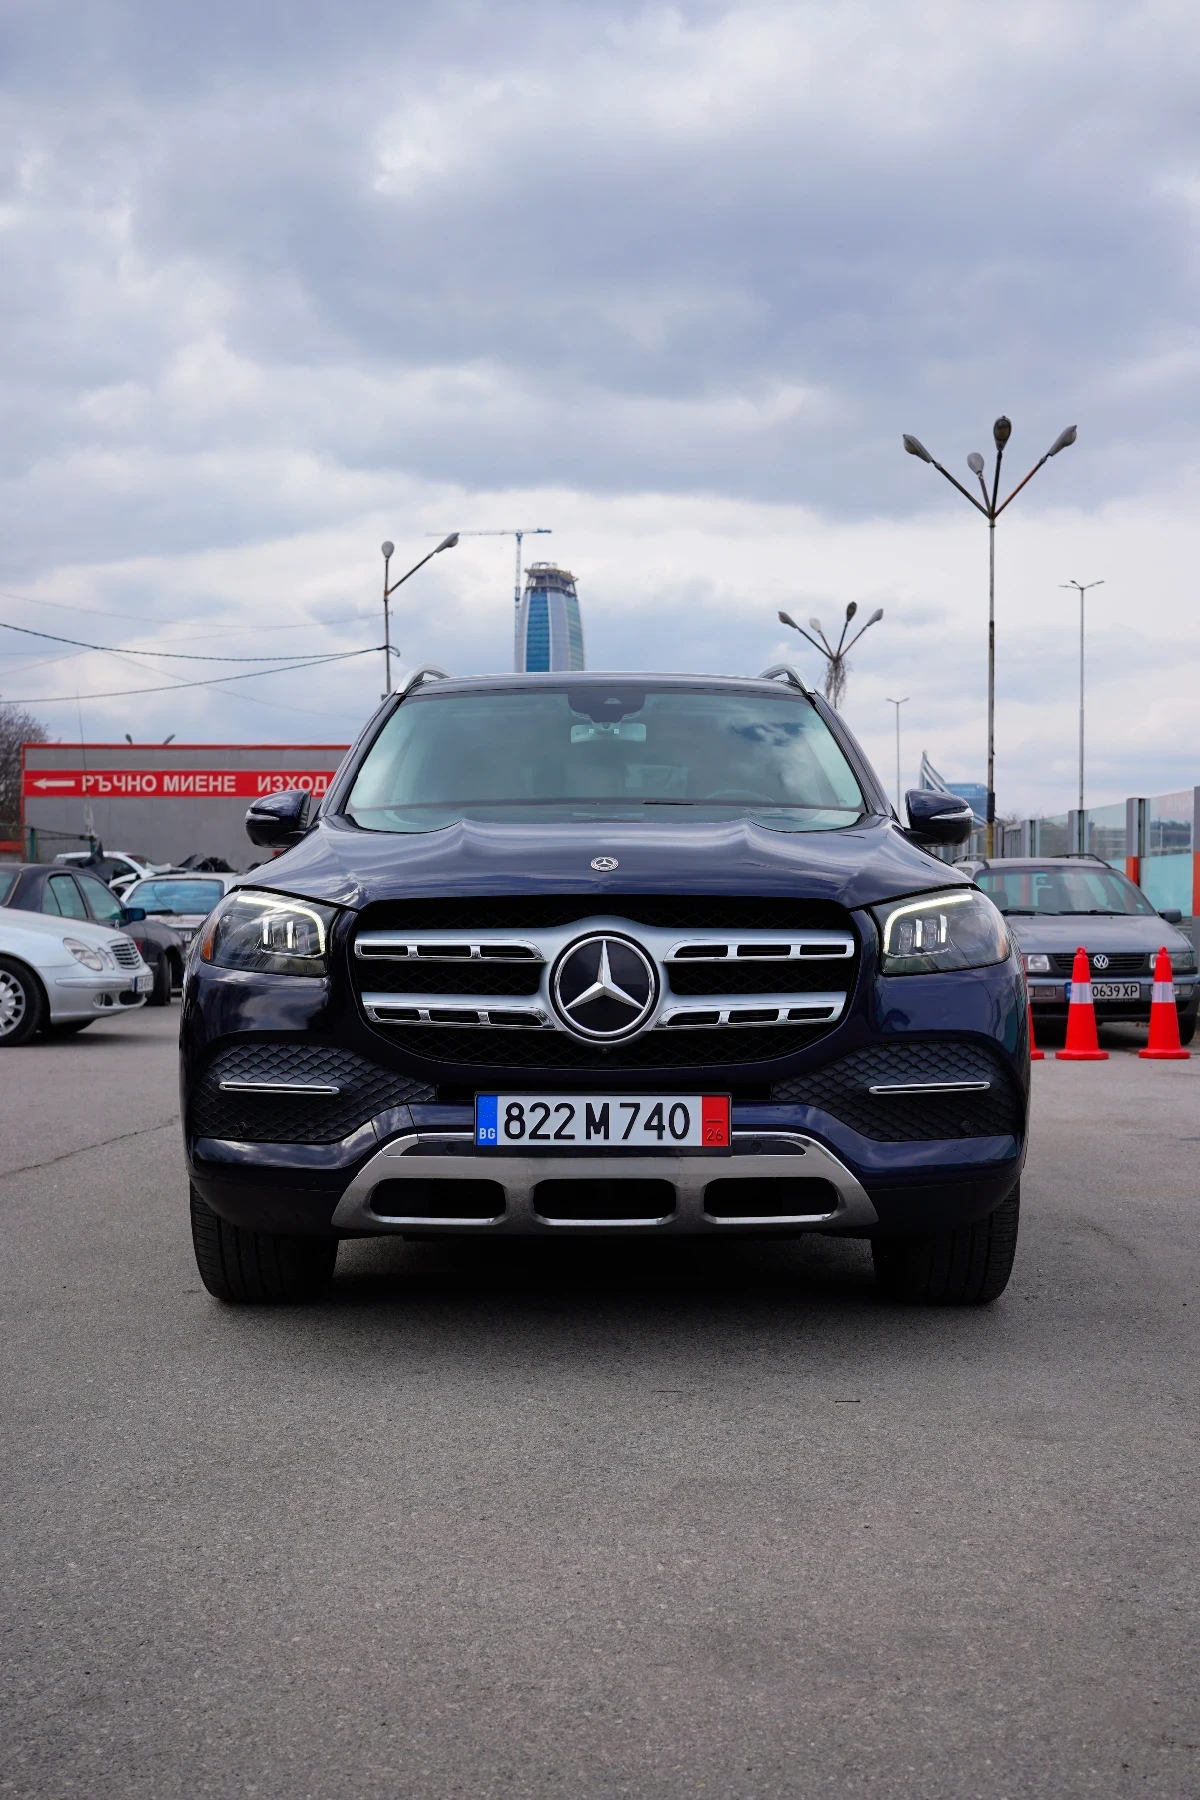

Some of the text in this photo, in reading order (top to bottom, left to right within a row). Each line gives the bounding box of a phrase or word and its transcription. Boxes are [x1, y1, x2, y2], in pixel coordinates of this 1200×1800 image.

[82, 775, 328, 796] РЪЧНО МИЕНЕ ИЗХОД
[1092, 985, 1120, 998] 0639
[504, 1101, 576, 1140] 822
[619, 1101, 691, 1140] 740
[479, 1127, 496, 1140] BG
[706, 1127, 724, 1141] 26
